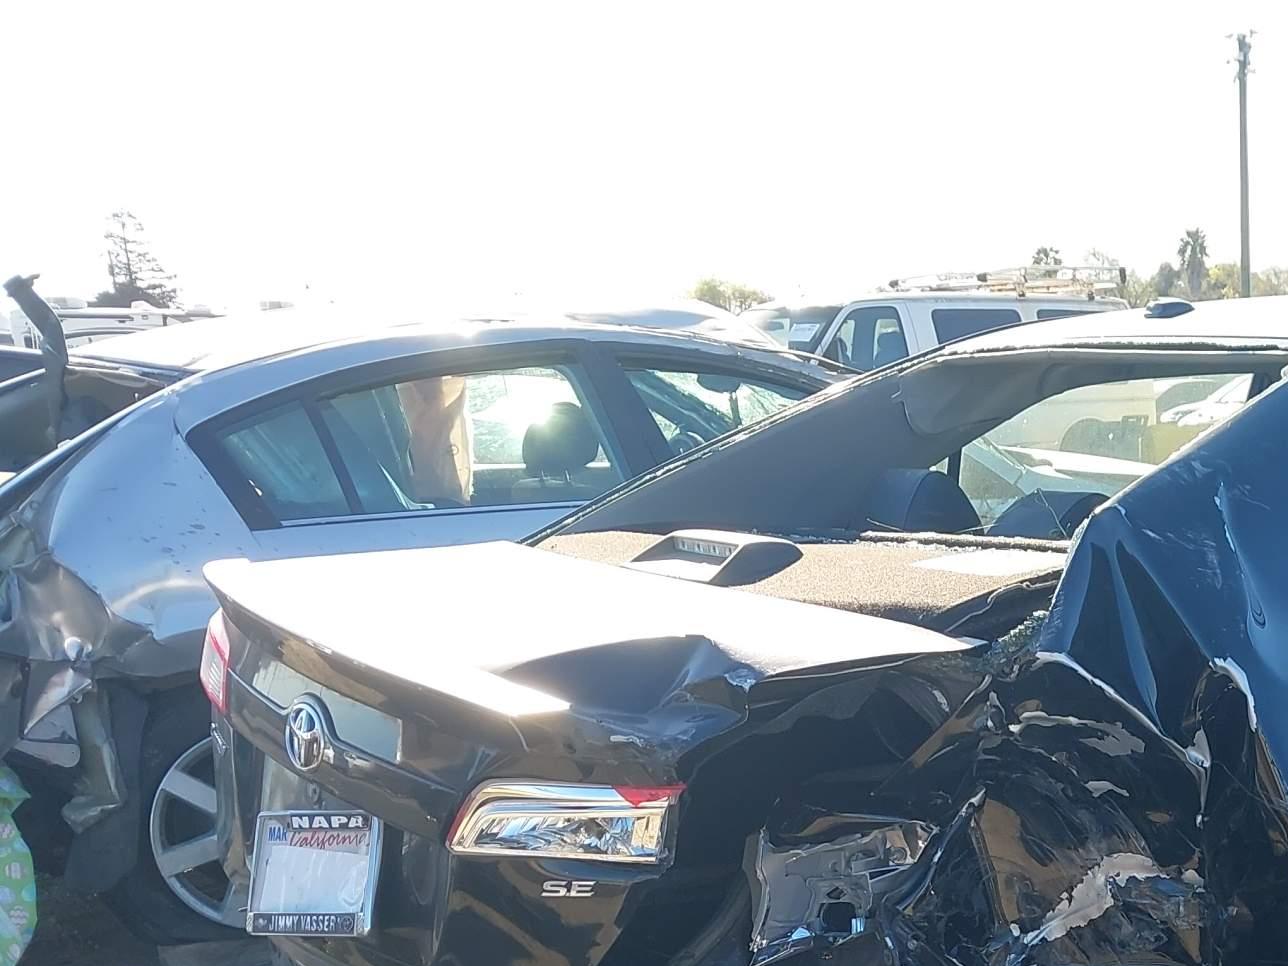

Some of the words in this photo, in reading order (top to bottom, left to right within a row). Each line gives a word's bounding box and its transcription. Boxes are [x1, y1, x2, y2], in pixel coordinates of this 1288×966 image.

[290, 815, 365, 829] NAPA
[289, 831, 370, 849] California
[541, 880, 597, 897] SE
[268, 915, 299, 931] JIMMY
